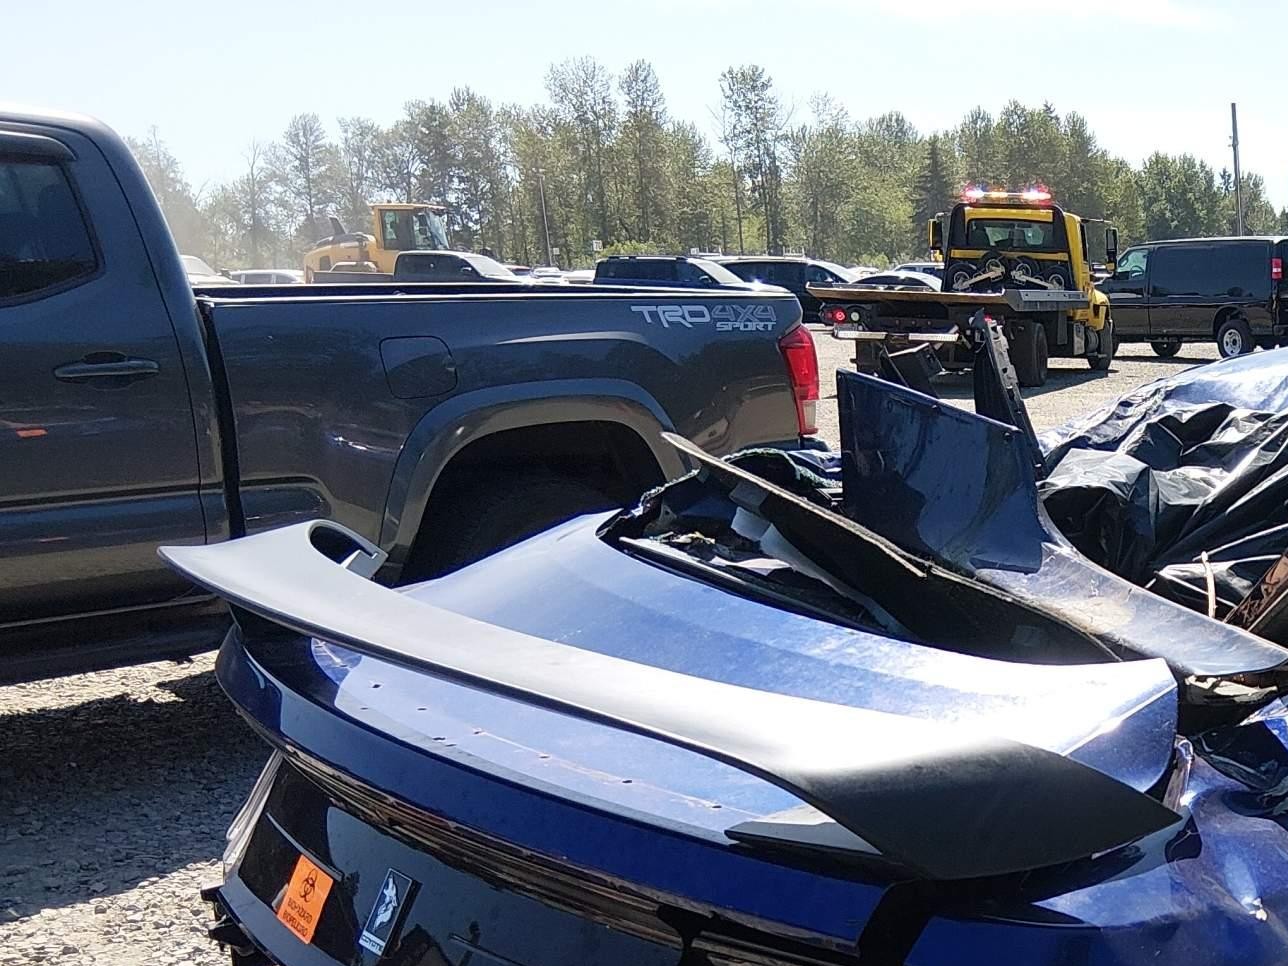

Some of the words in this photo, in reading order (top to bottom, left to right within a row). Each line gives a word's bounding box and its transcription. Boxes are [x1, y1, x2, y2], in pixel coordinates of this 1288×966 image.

[631, 305, 710, 328] TRD
[716, 321, 777, 331] SPORT
[287, 897, 313, 925] BIOHAZARD
[361, 934, 384, 952] COYOTE
